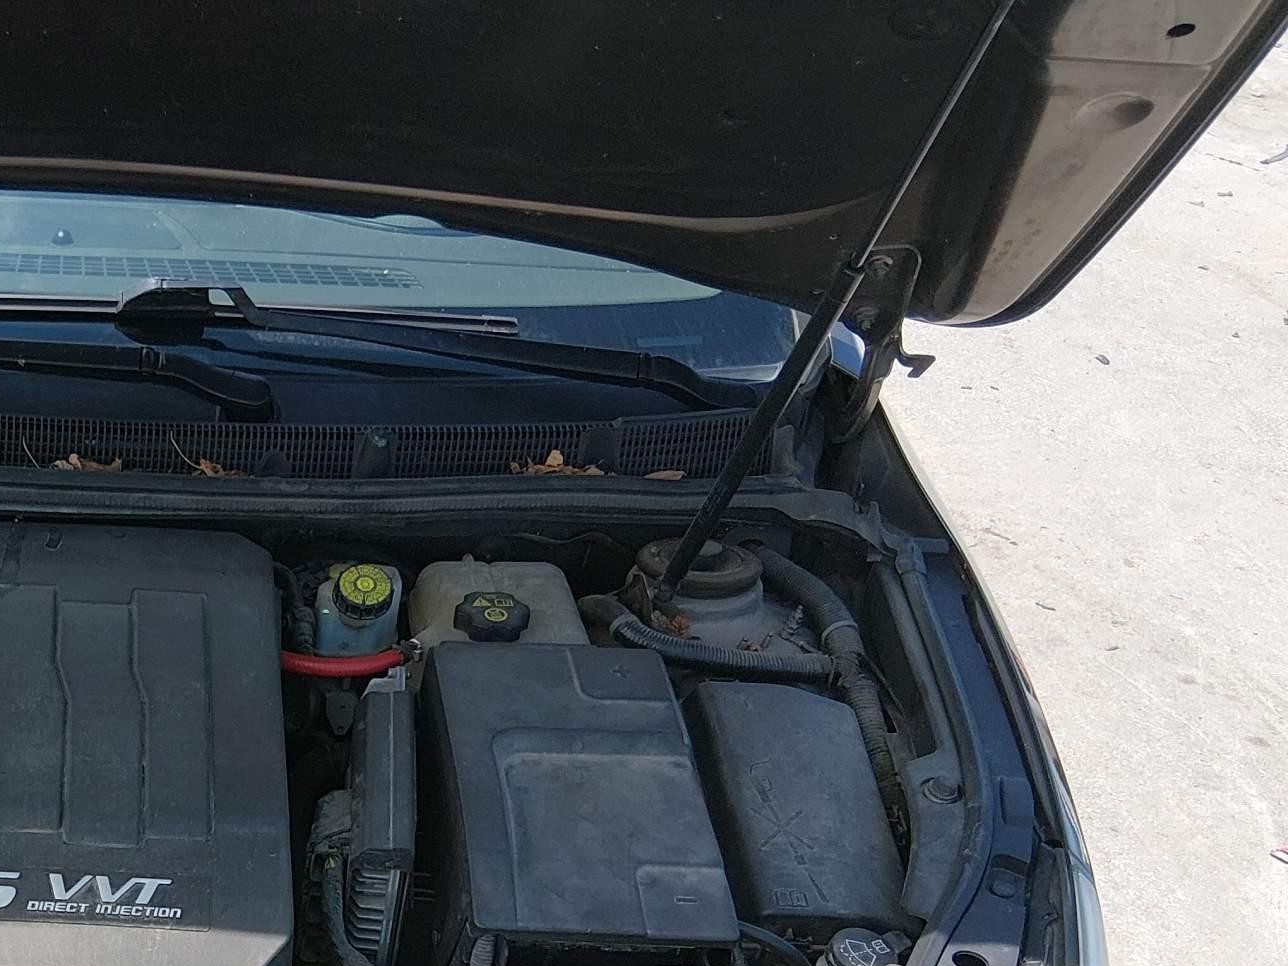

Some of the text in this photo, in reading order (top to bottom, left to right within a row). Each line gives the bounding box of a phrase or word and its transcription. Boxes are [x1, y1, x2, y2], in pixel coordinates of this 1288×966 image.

[49, 873, 173, 906] VVT
[26, 900, 183, 919] DIRECT INJECTION
